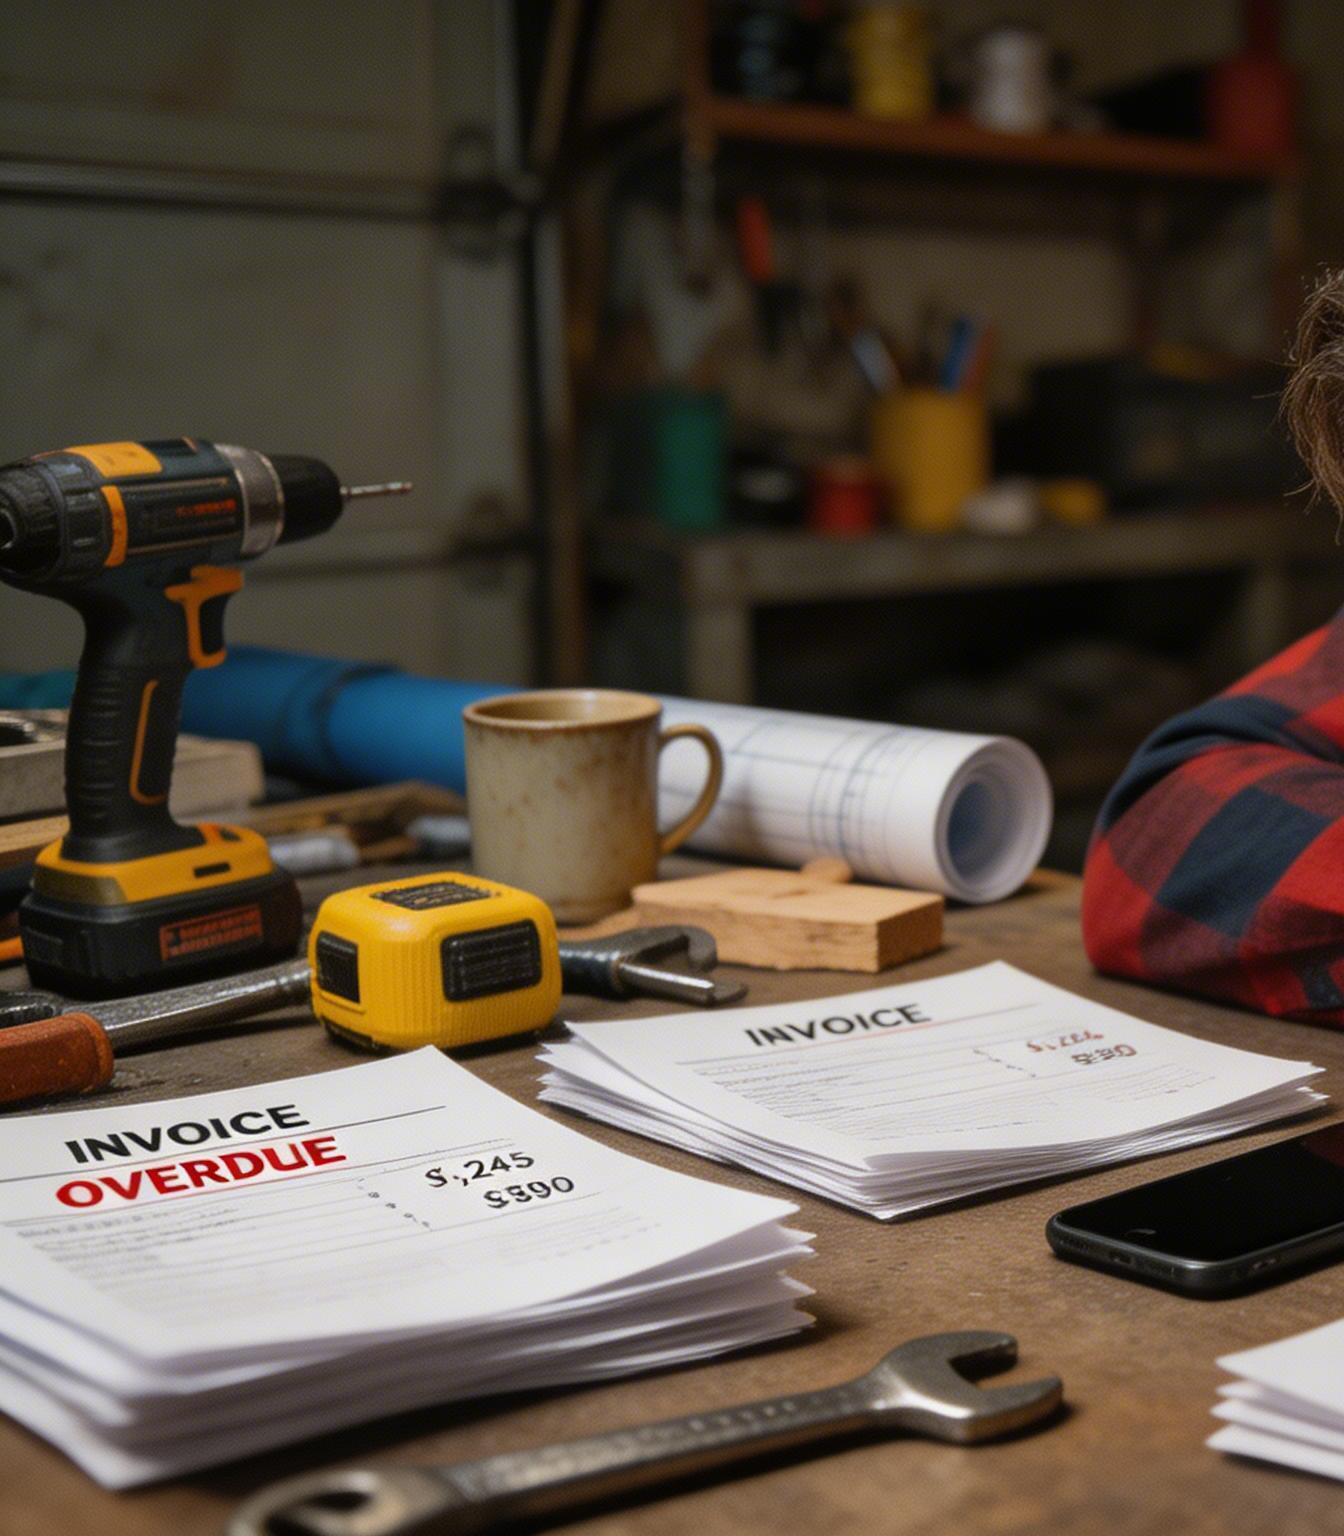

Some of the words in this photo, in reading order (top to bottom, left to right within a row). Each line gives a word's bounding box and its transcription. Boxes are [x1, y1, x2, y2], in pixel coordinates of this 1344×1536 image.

[744, 1002, 931, 1046] INVOICE
[65, 1104, 311, 1163] INVOICE
[55, 1136, 347, 1208] OVERDUE
